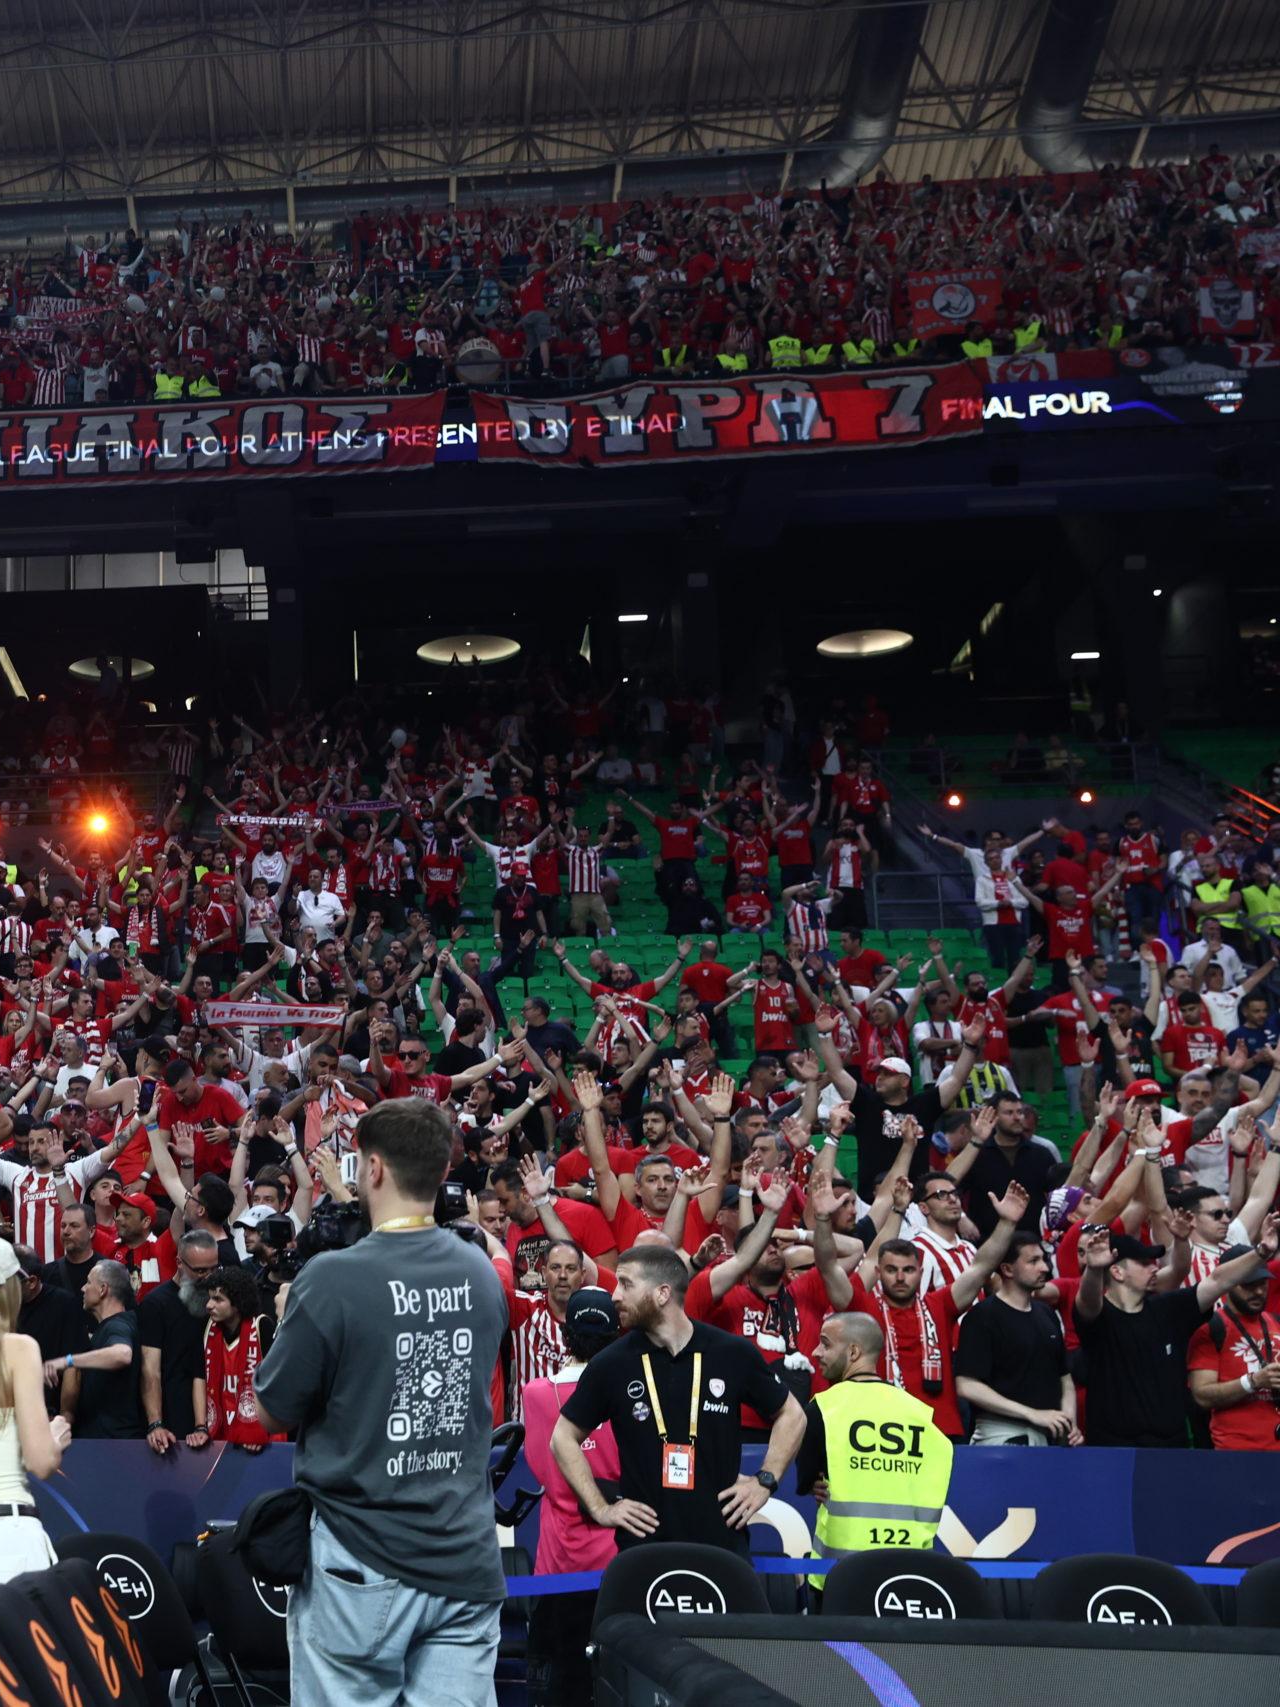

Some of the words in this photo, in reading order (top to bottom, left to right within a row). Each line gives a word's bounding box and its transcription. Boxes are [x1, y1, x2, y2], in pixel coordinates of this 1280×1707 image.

[941, 395, 1026, 421] FINAL
[1028, 391, 1112, 417] FOUR
[106, 438, 178, 461] FINAL
[187, 434, 258, 456] FOUR
[268, 428, 367, 453] ATHENS
[541, 417, 576, 440] BY
[586, 412, 687, 438] ETIHAD
[768, 996, 781, 1008] 10
[286, 1008, 305, 1019] We
[762, 1010, 788, 1023] bwin
[388, 1279, 422, 1317] Be
[425, 1278, 473, 1323] part
[703, 1399, 729, 1414] bwin
[849, 1420, 925, 1459] CSI
[386, 1450, 406, 1477] of
[406, 1449, 426, 1474] the
[425, 1447, 463, 1475] story.
[849, 1455, 923, 1475] SECURITY
[869, 1527, 911, 1546] 122
[1096, 1603, 1158, 1626] ΔΕ
